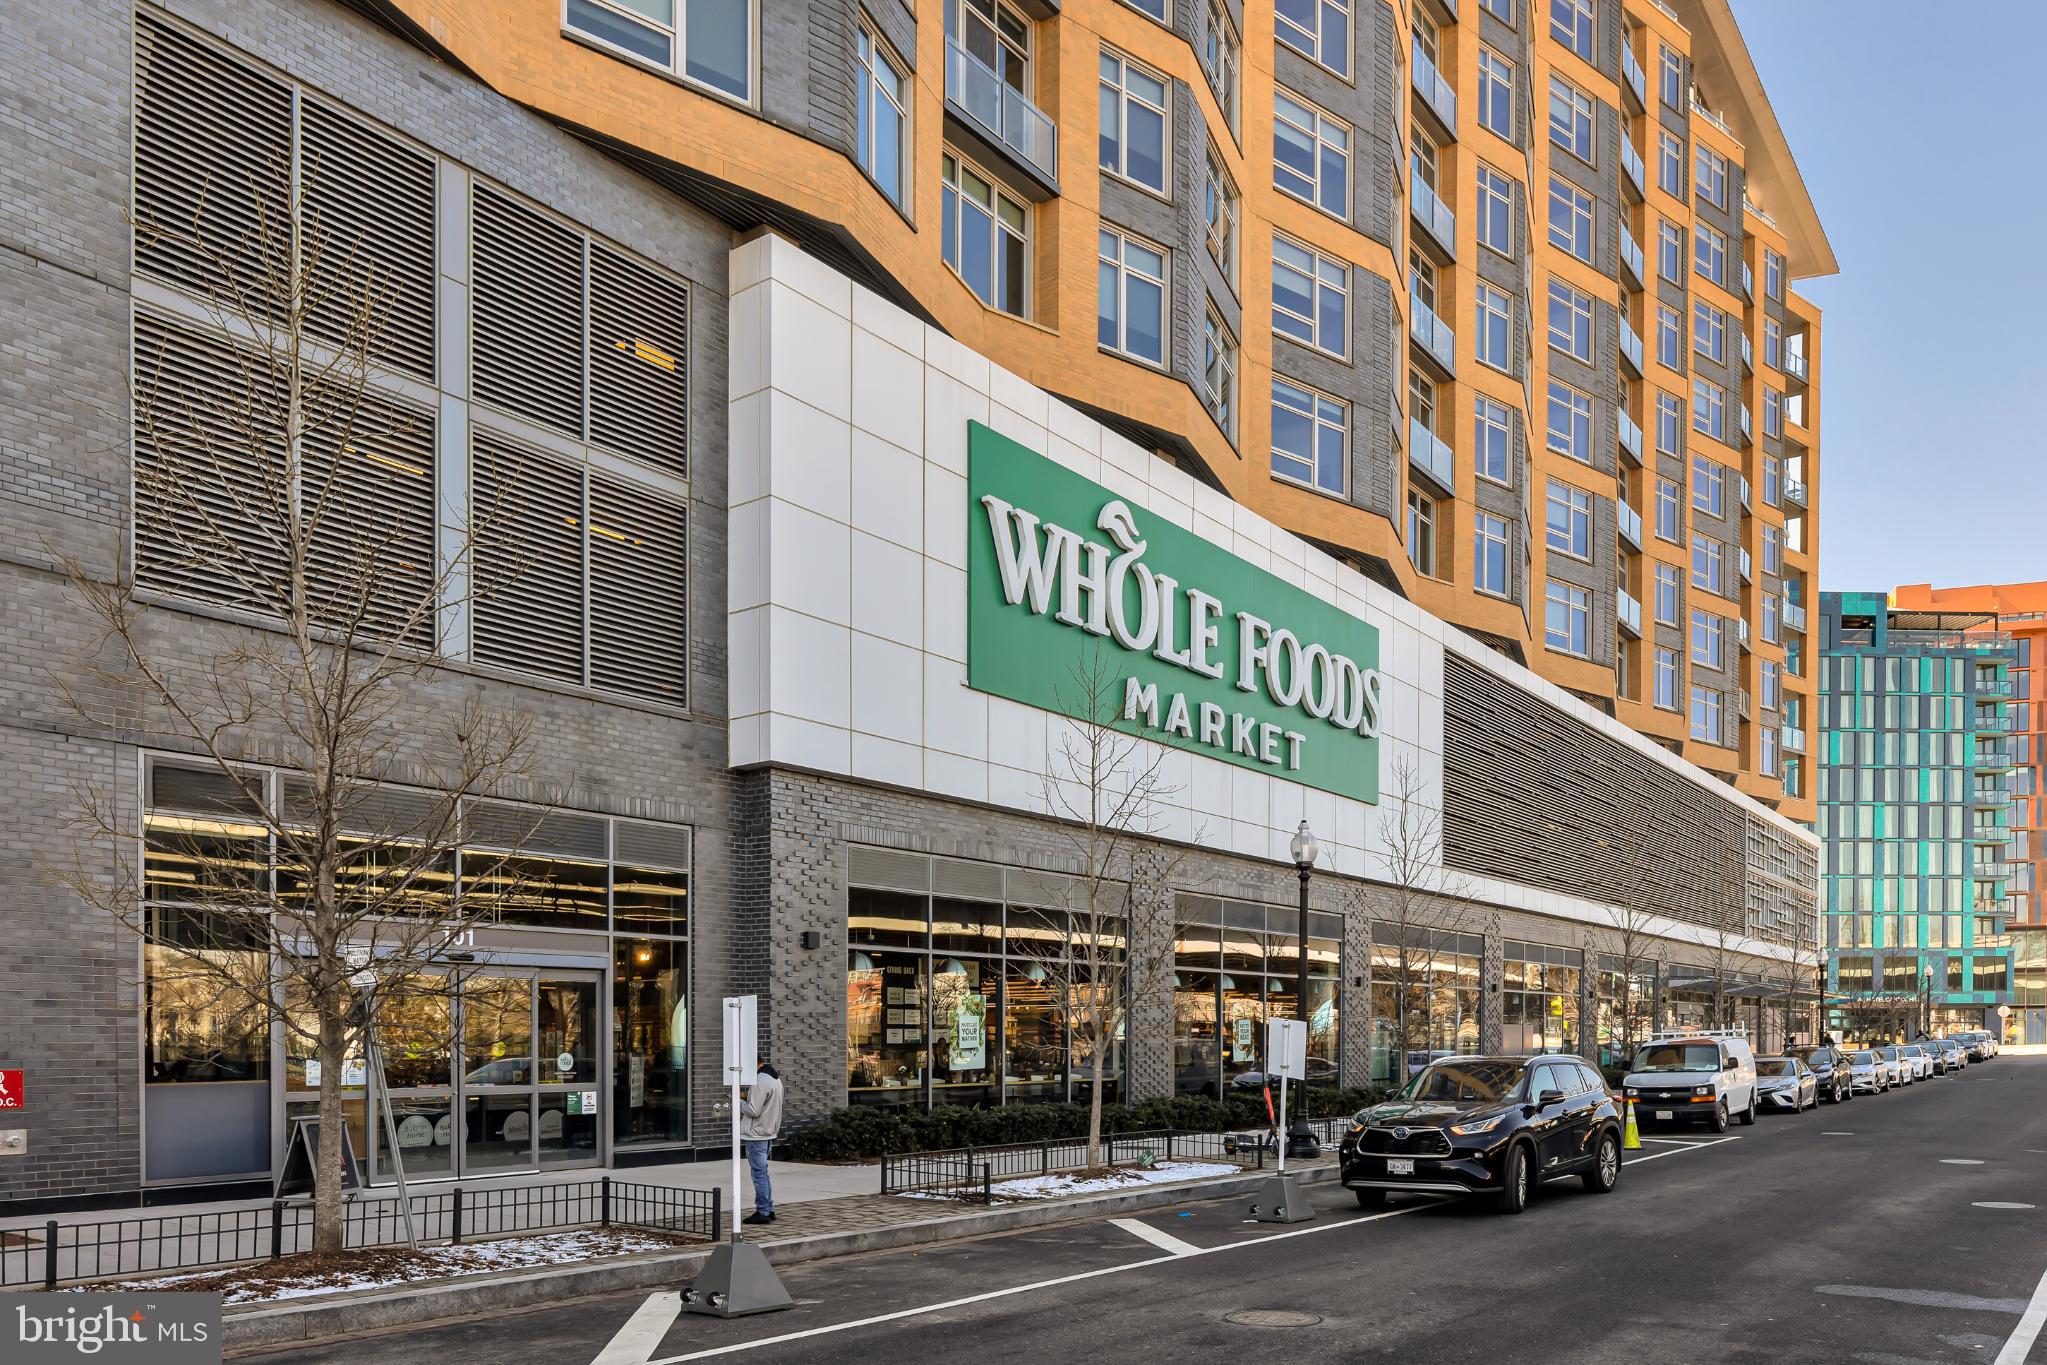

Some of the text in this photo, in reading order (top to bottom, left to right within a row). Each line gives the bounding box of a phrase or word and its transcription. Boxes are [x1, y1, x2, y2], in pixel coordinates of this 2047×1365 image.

[981, 495, 1382, 738] WHOLE FOODS
[1124, 677, 1306, 770] MARKET
[961, 1028, 978, 1036] YOUR
